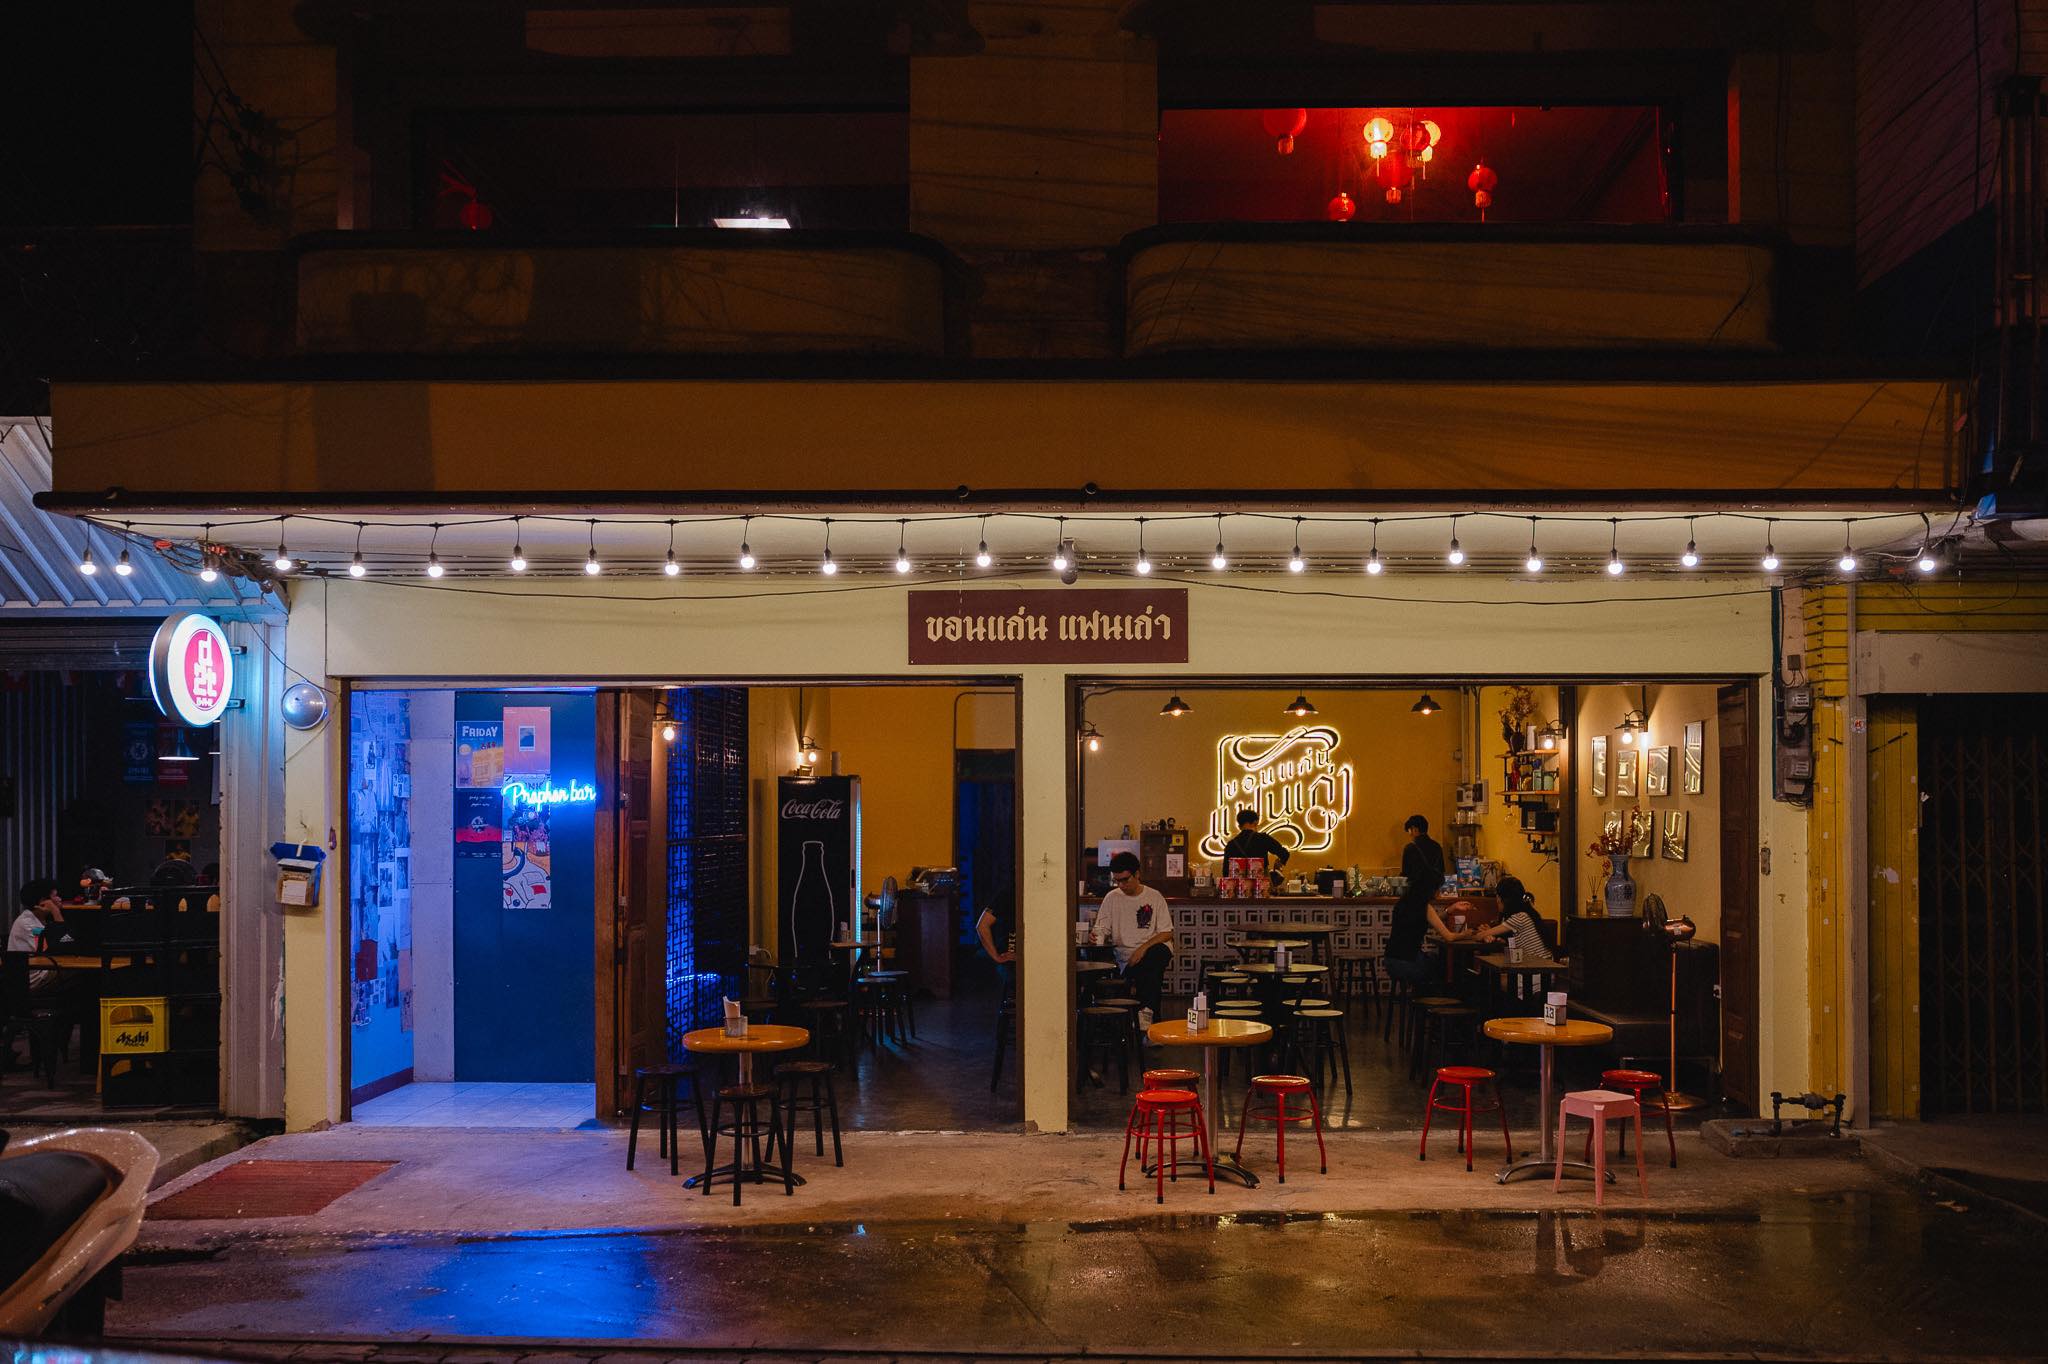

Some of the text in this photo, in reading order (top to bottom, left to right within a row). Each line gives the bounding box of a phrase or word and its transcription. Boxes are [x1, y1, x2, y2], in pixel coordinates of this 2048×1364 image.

[925, 605, 1171, 642] ขอนแก่น แฟนเก่า
[461, 725, 498, 737] FRIDAY
[569, 779, 597, 802] bar
[781, 798, 844, 819] Coca-Cola
